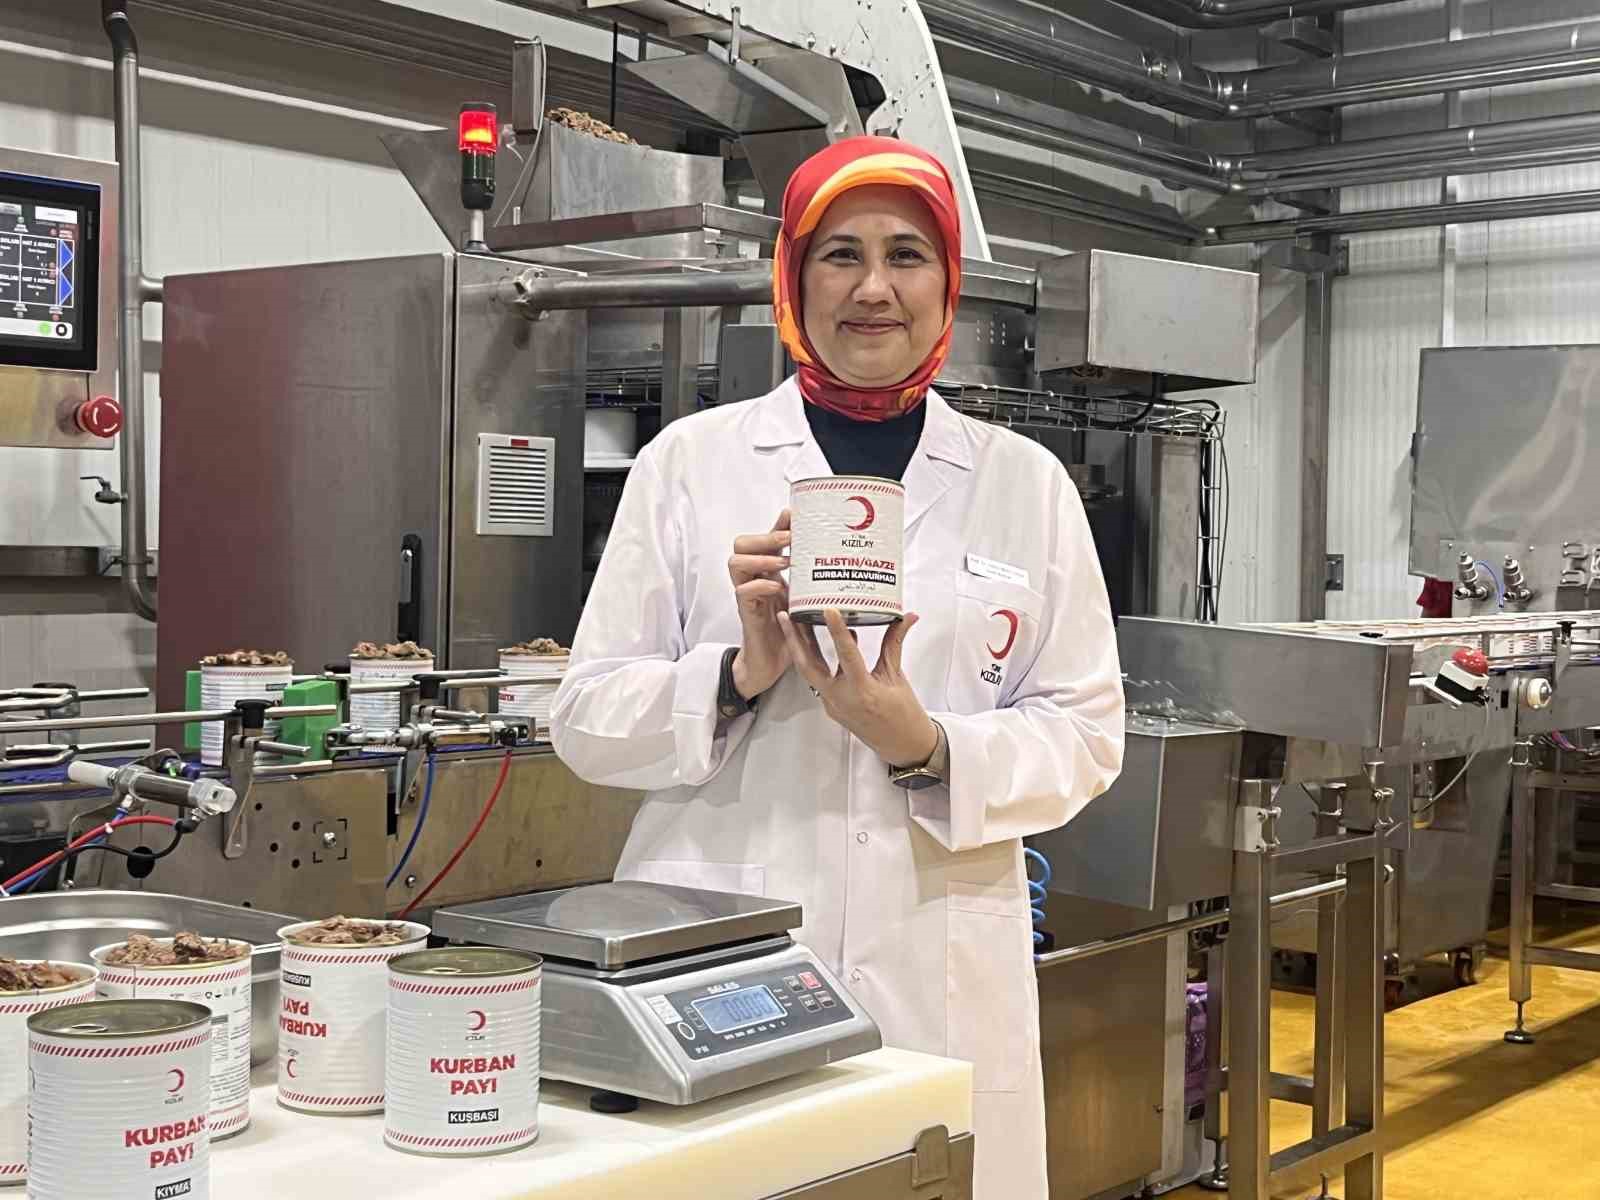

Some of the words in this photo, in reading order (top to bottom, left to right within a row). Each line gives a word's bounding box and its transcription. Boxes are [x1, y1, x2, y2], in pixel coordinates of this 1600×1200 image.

[814, 571, 850, 580] KURBAN
[851, 572, 895, 584] KAVURMASI
[430, 1055, 516, 1073] KURBAN
[451, 1078, 497, 1095] PAYI
[150, 1142, 193, 1168] PAYI
[157, 1181, 190, 1199] KIYMA
